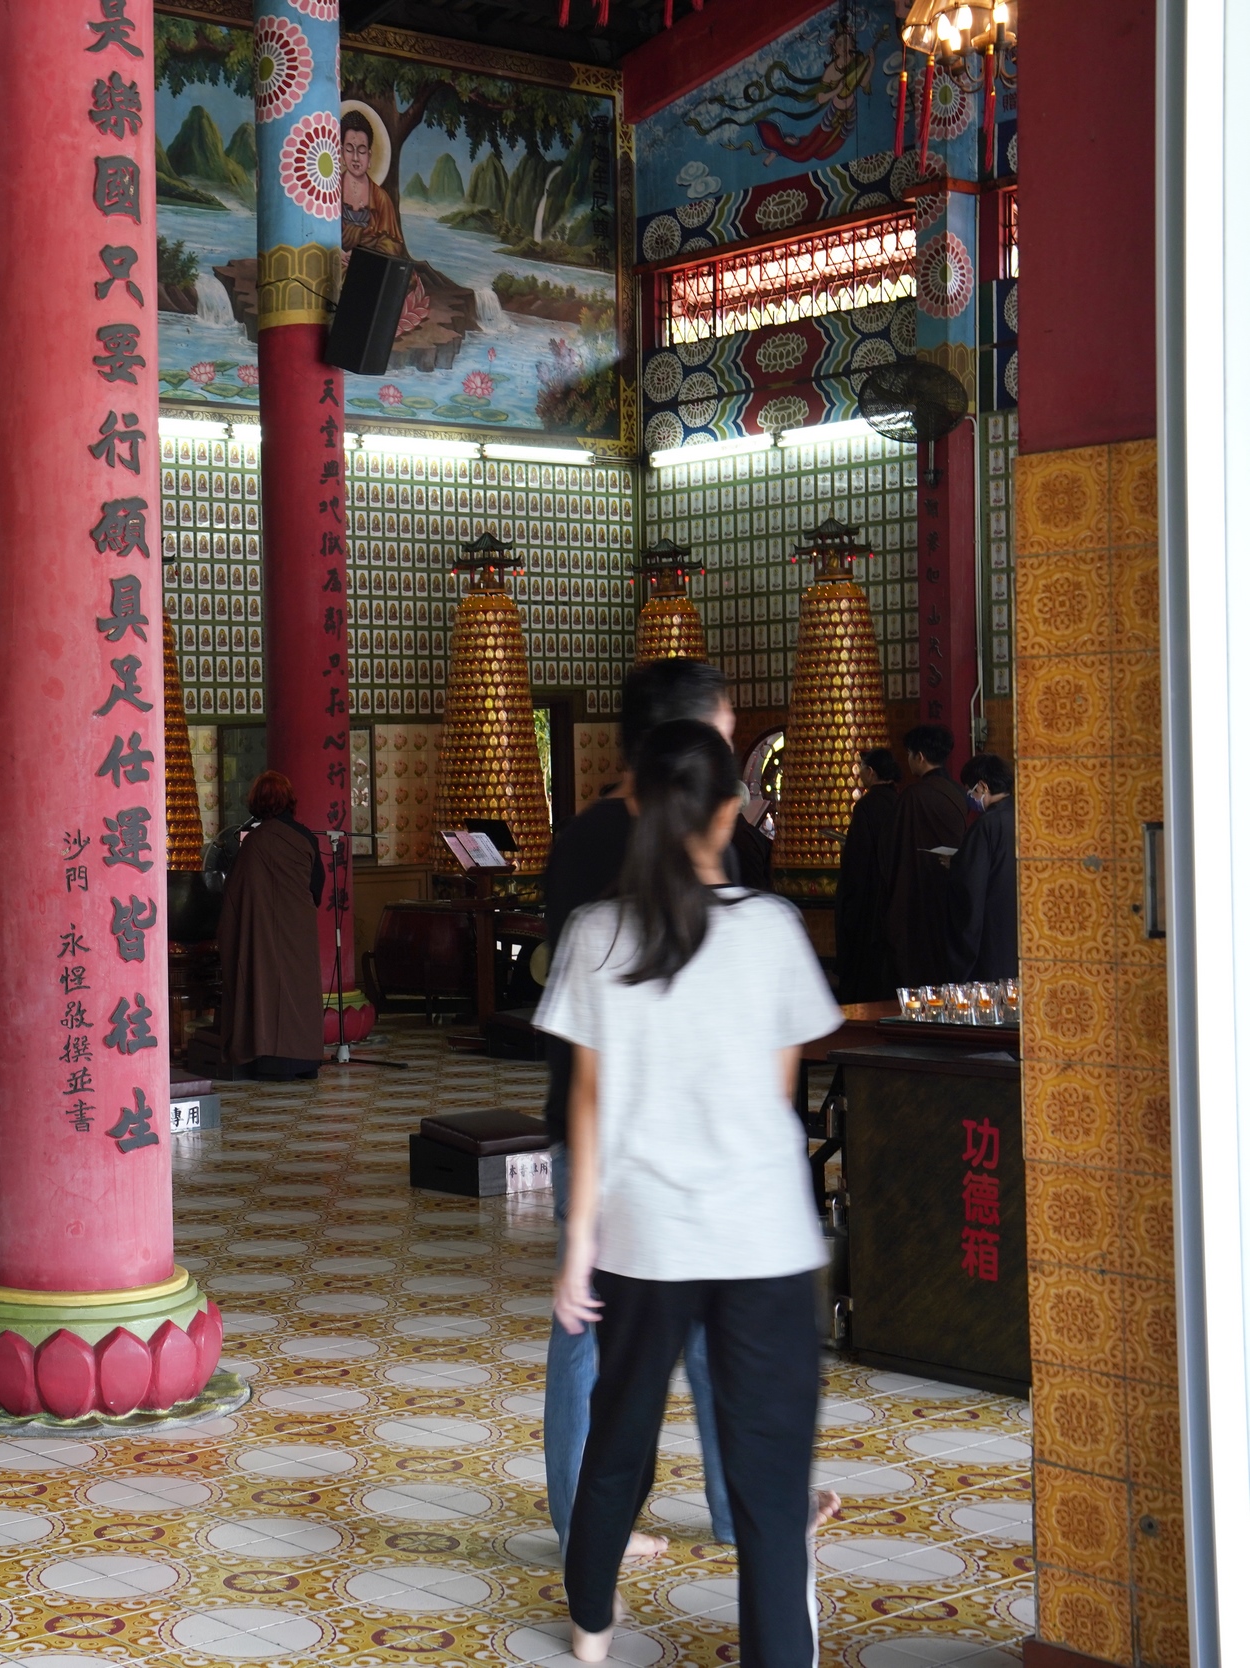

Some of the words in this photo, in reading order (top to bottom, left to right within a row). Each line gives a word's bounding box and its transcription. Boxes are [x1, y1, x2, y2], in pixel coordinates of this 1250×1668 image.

[60, 829, 90, 893] 沙門
[961, 1117, 1000, 1282] 功德箱
